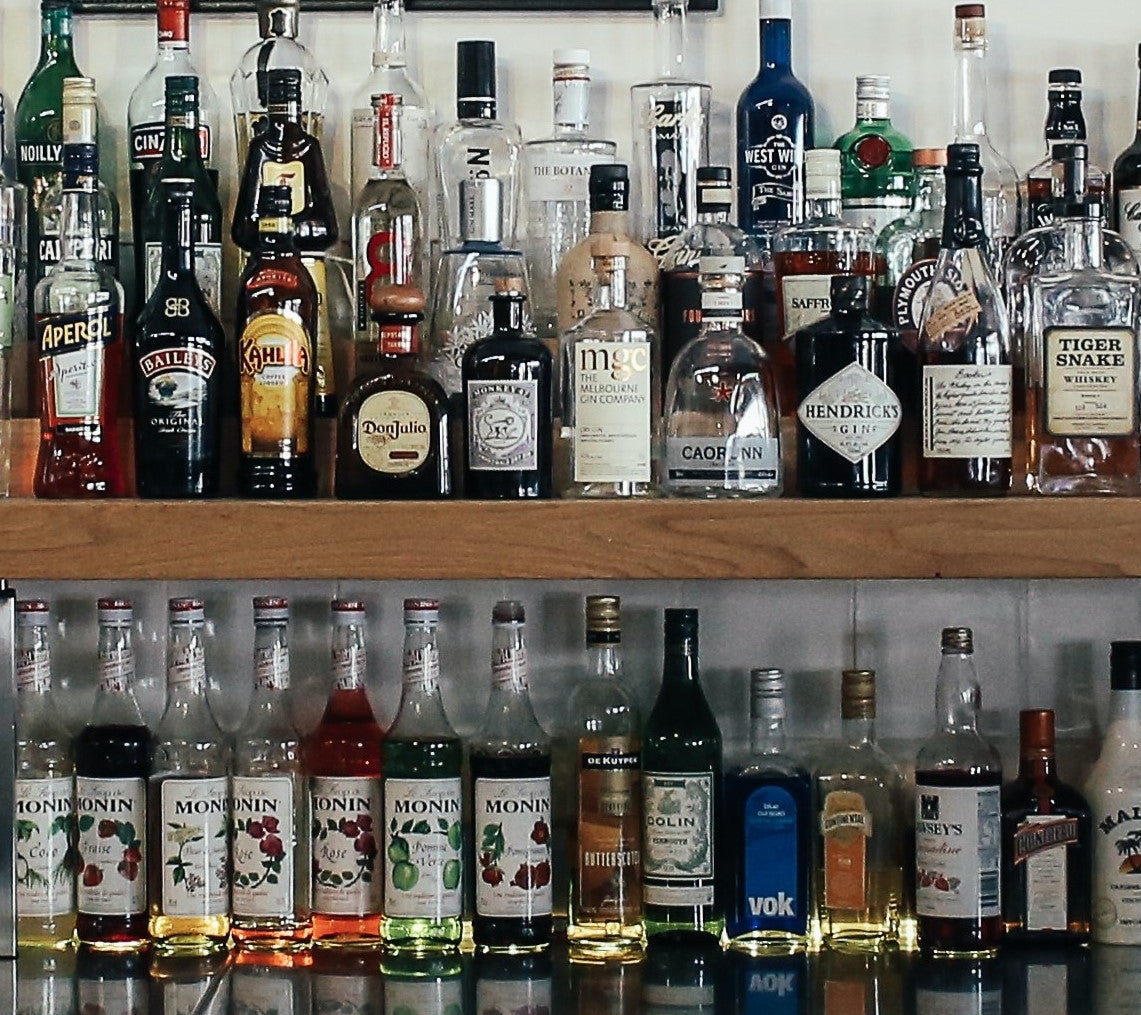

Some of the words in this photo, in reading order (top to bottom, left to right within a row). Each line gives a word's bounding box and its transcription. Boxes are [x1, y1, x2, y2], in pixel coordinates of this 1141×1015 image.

[20, 145, 62, 162] NOILLY
[745, 149, 774, 164] WEST
[534, 166, 550, 176] THE
[553, 166, 592, 176] BOTAN
[792, 297, 832, 310] SAFFR
[41, 316, 112, 352] APEROL
[1058, 338, 1122, 353] TIGER
[144, 349, 212, 374] BAILEYS
[579, 345, 648, 382] mgc
[1056, 353, 1126, 368] SNAKE
[1063, 375, 1118, 385] WHISKEY
[580, 385, 639, 395] MELBOURNE
[580, 395, 598, 405] GIN
[600, 395, 648, 405] COMPANY
[804, 403, 900, 420] HENDRICK'S
[839, 424, 872, 435] GIN
[394, 799, 460, 814] MONIN
[485, 799, 550, 814] MONIN
[747, 891, 795, 917] vok
